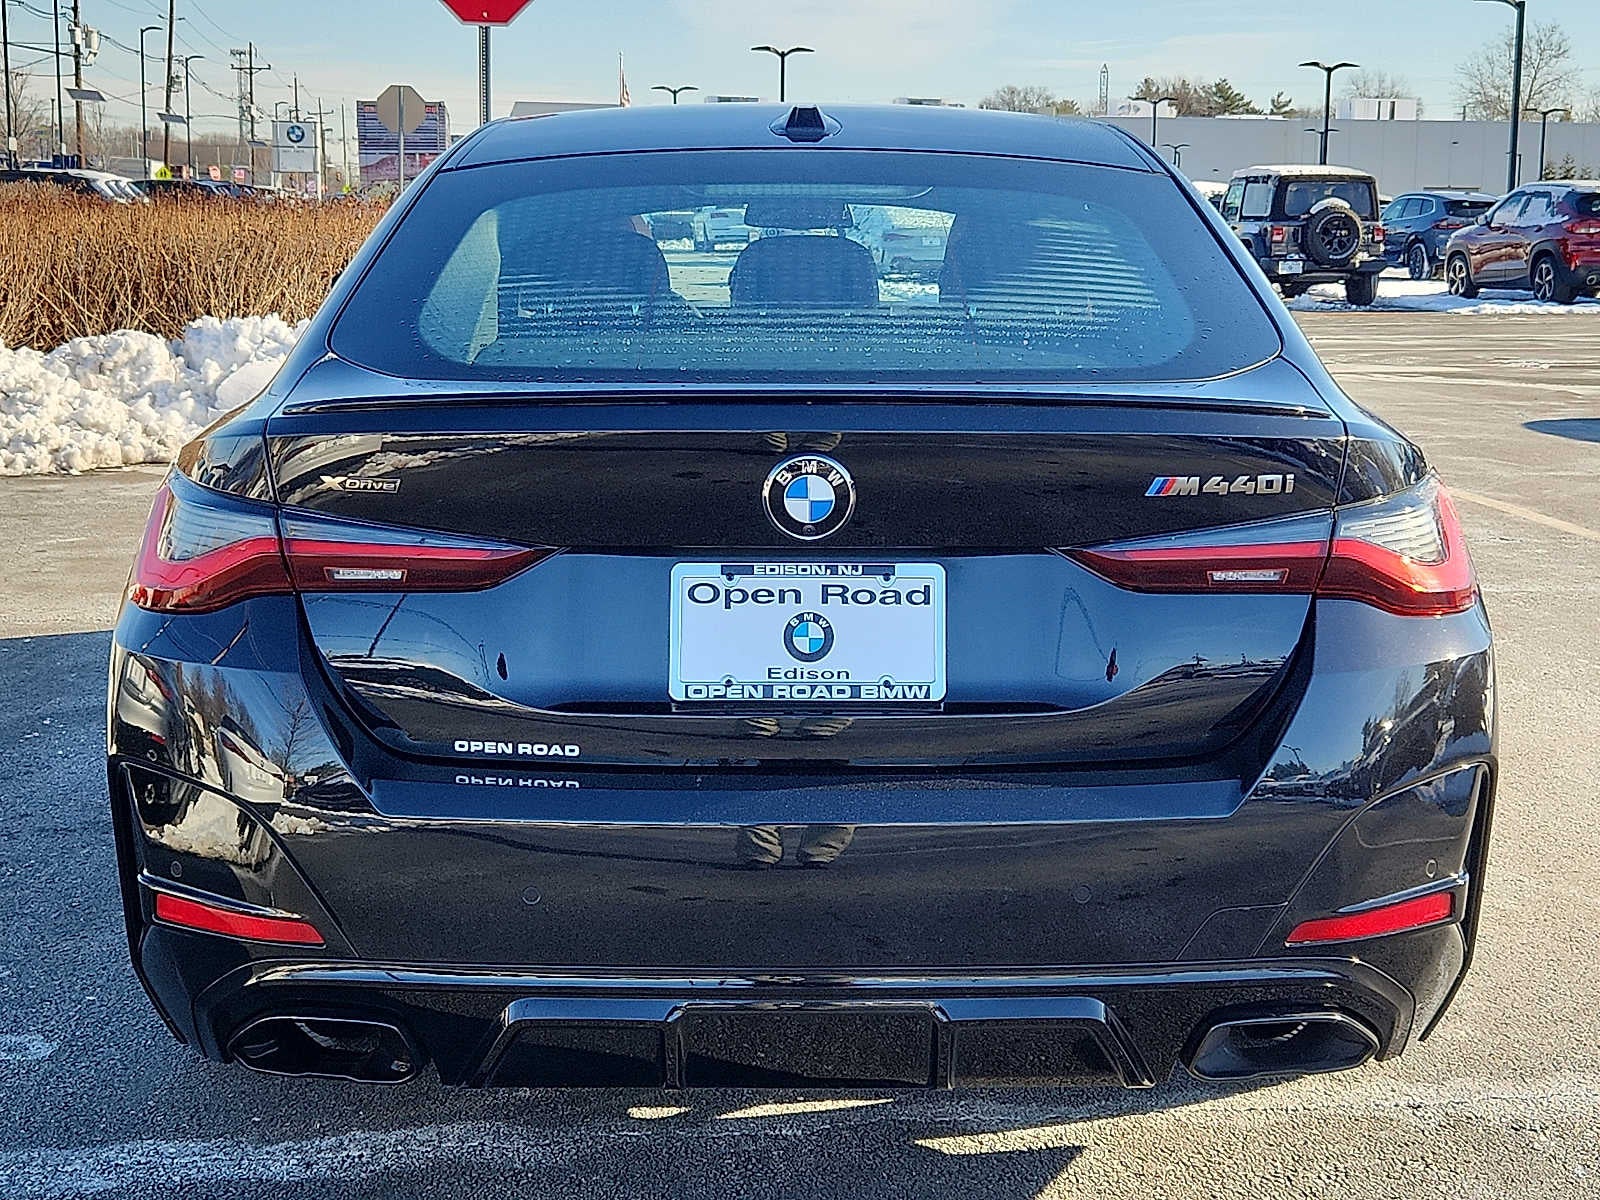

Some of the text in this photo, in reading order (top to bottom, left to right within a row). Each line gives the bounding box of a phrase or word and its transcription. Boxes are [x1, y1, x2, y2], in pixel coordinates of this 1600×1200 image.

[775, 460, 845, 487] BMW
[753, 564, 863, 576] EDISON, NJ
[687, 582, 931, 609] Open Road
[789, 612, 830, 628] BMW
[767, 667, 850, 680] Edison
[687, 684, 929, 699] OPEN ROAD BMW
[454, 740, 580, 757] OPEN ROAD
